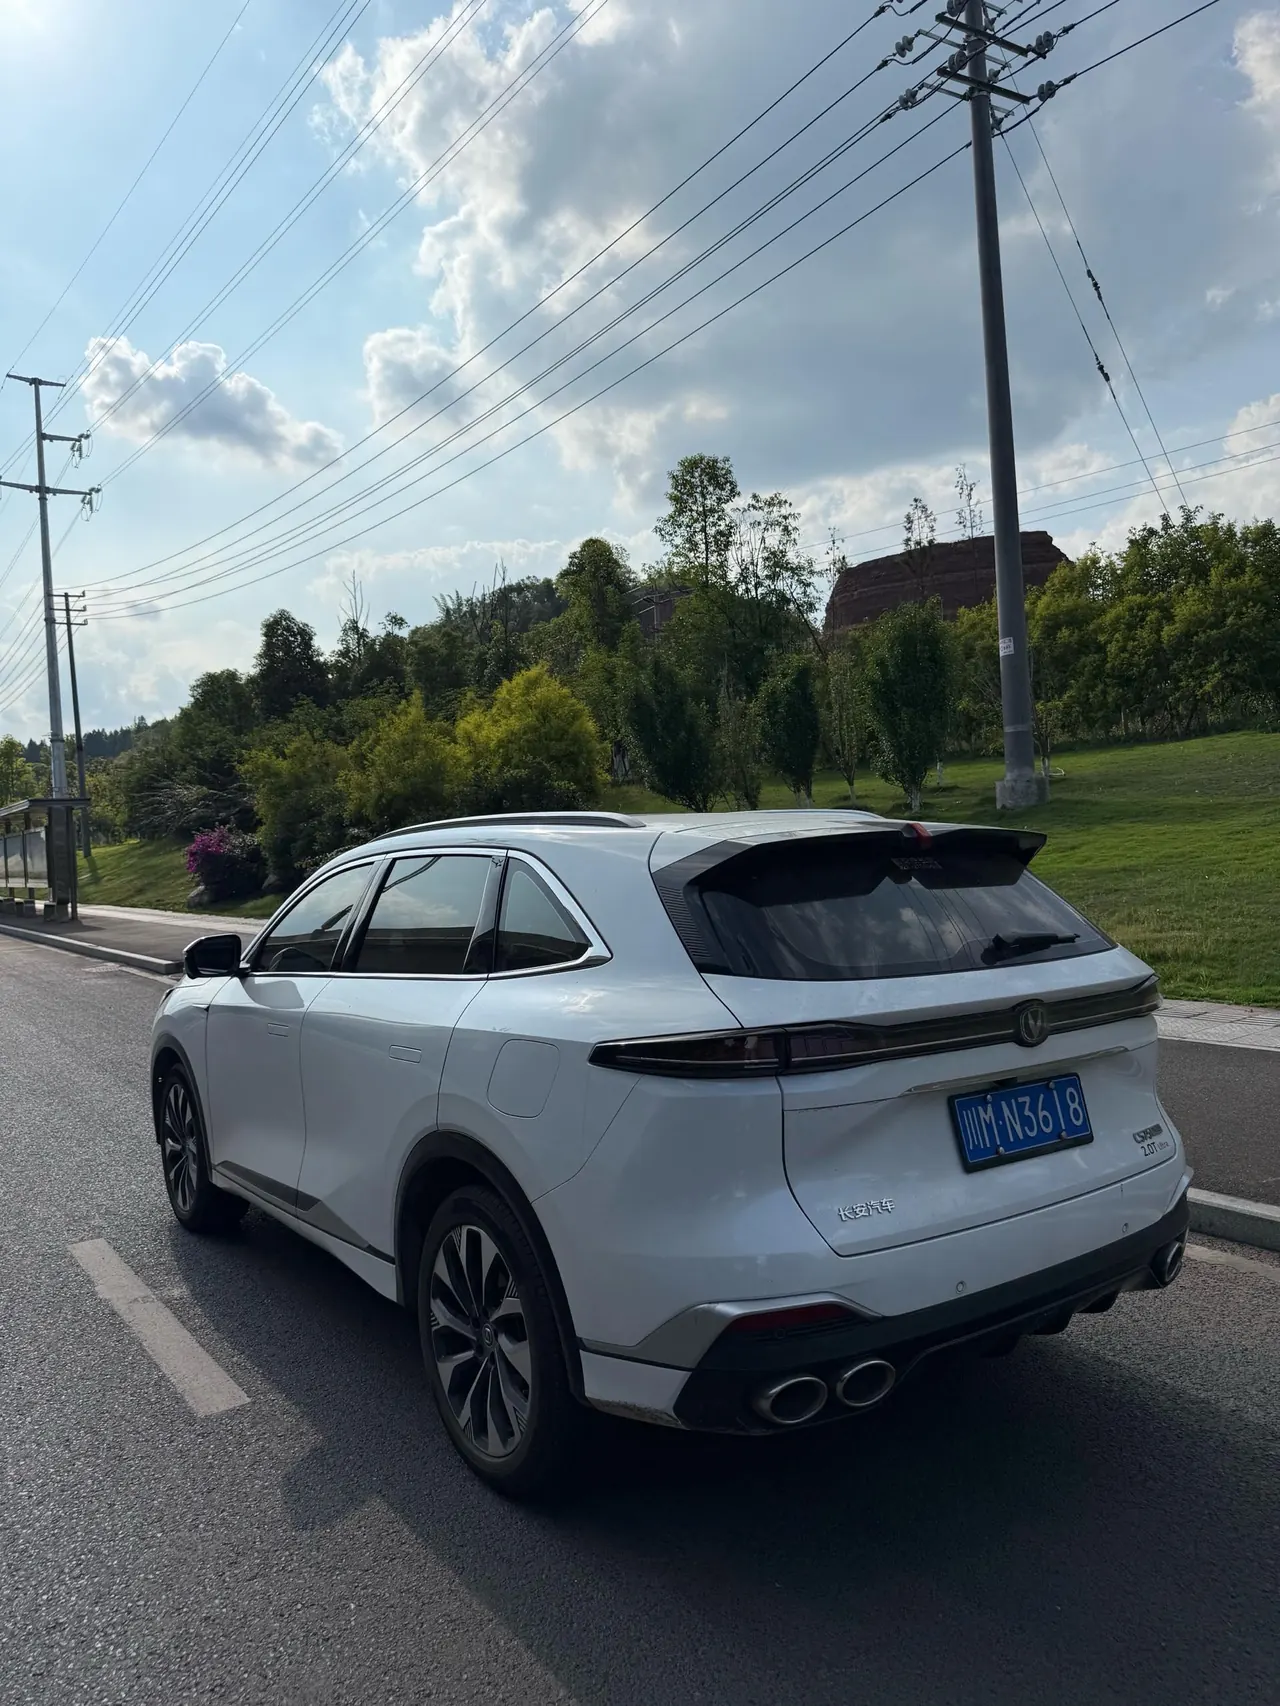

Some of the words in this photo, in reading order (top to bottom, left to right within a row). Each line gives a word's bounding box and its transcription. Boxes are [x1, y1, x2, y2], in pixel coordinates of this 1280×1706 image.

[1140, 1142, 1158, 1157] 2.0T
[838, 1198, 896, 1221] 长安汽车
